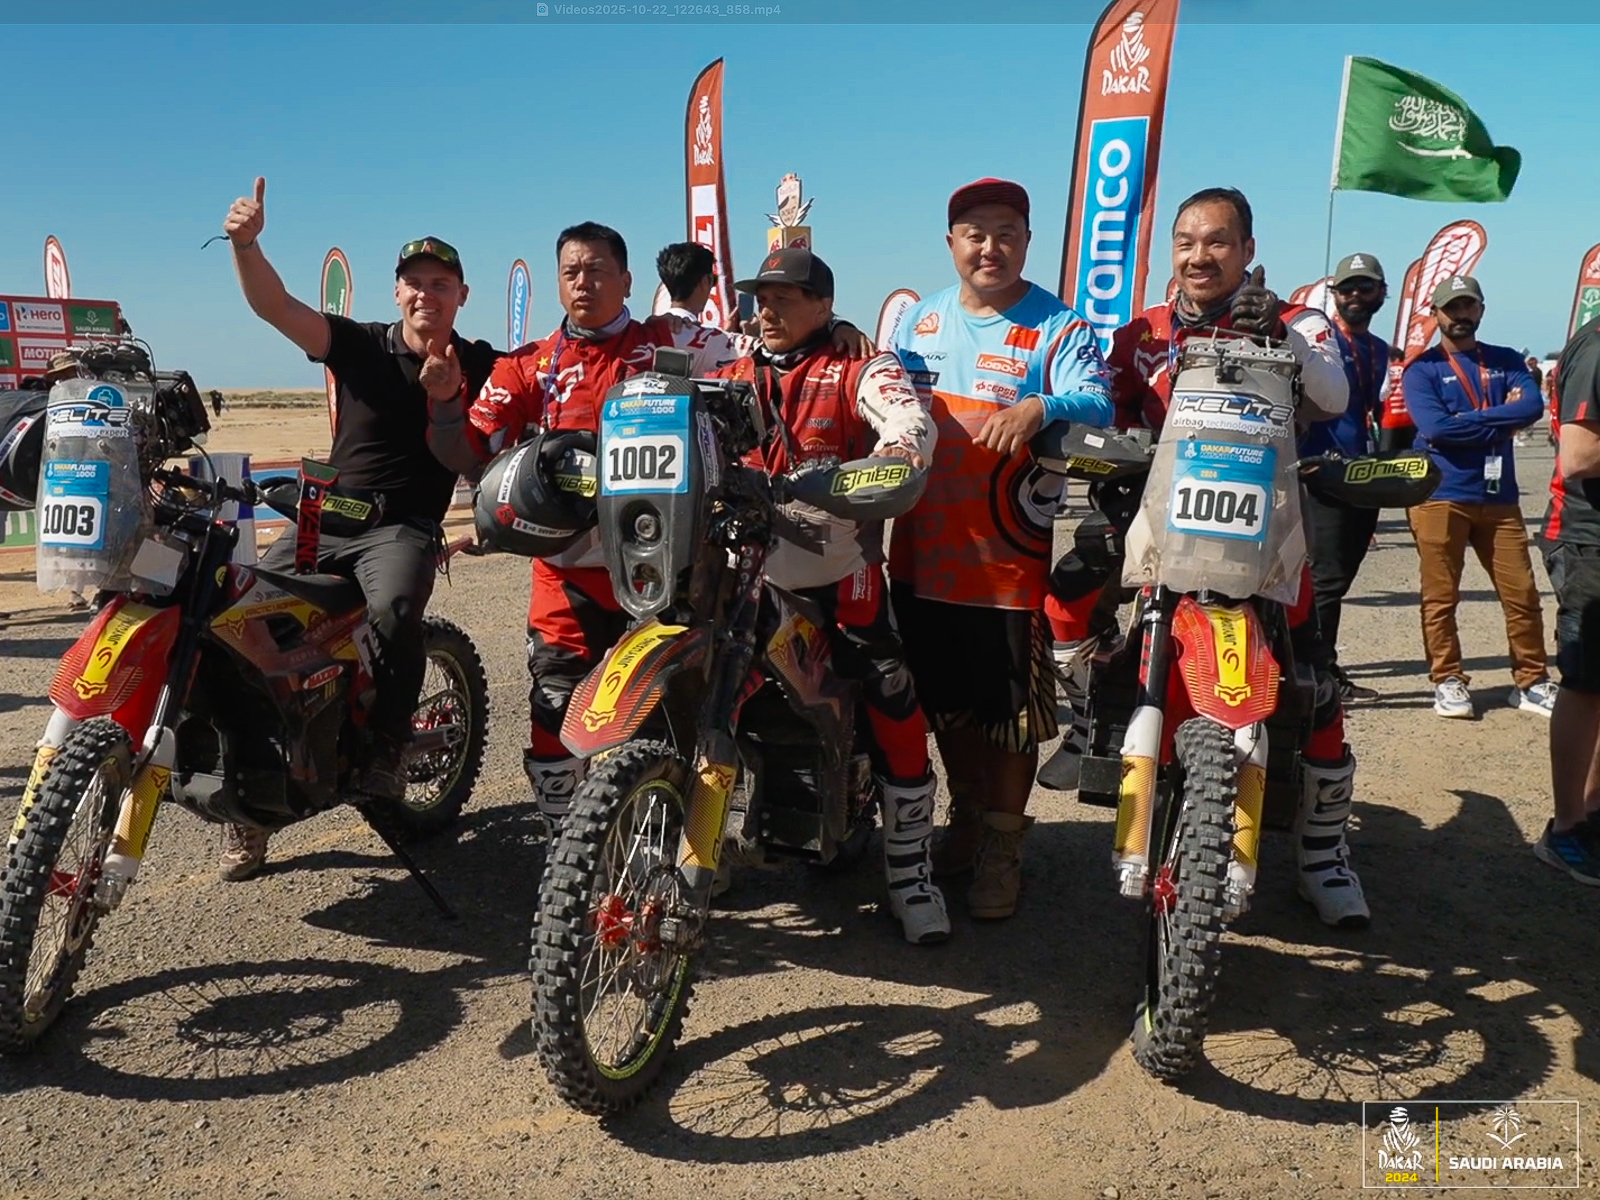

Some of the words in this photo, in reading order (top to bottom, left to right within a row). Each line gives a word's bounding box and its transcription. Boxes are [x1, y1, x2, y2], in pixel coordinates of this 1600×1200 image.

[1101, 66, 1150, 95] DAKAR
[30, 308, 62, 321] Hero
[513, 272, 524, 349] ramco
[1178, 396, 1293, 423] HELITE
[1173, 416, 1204, 429] airbag
[1205, 418, 1258, 436] technology
[608, 444, 677, 482] 1002
[43, 503, 96, 536] 1003
[1175, 486, 1260, 528] 1004
